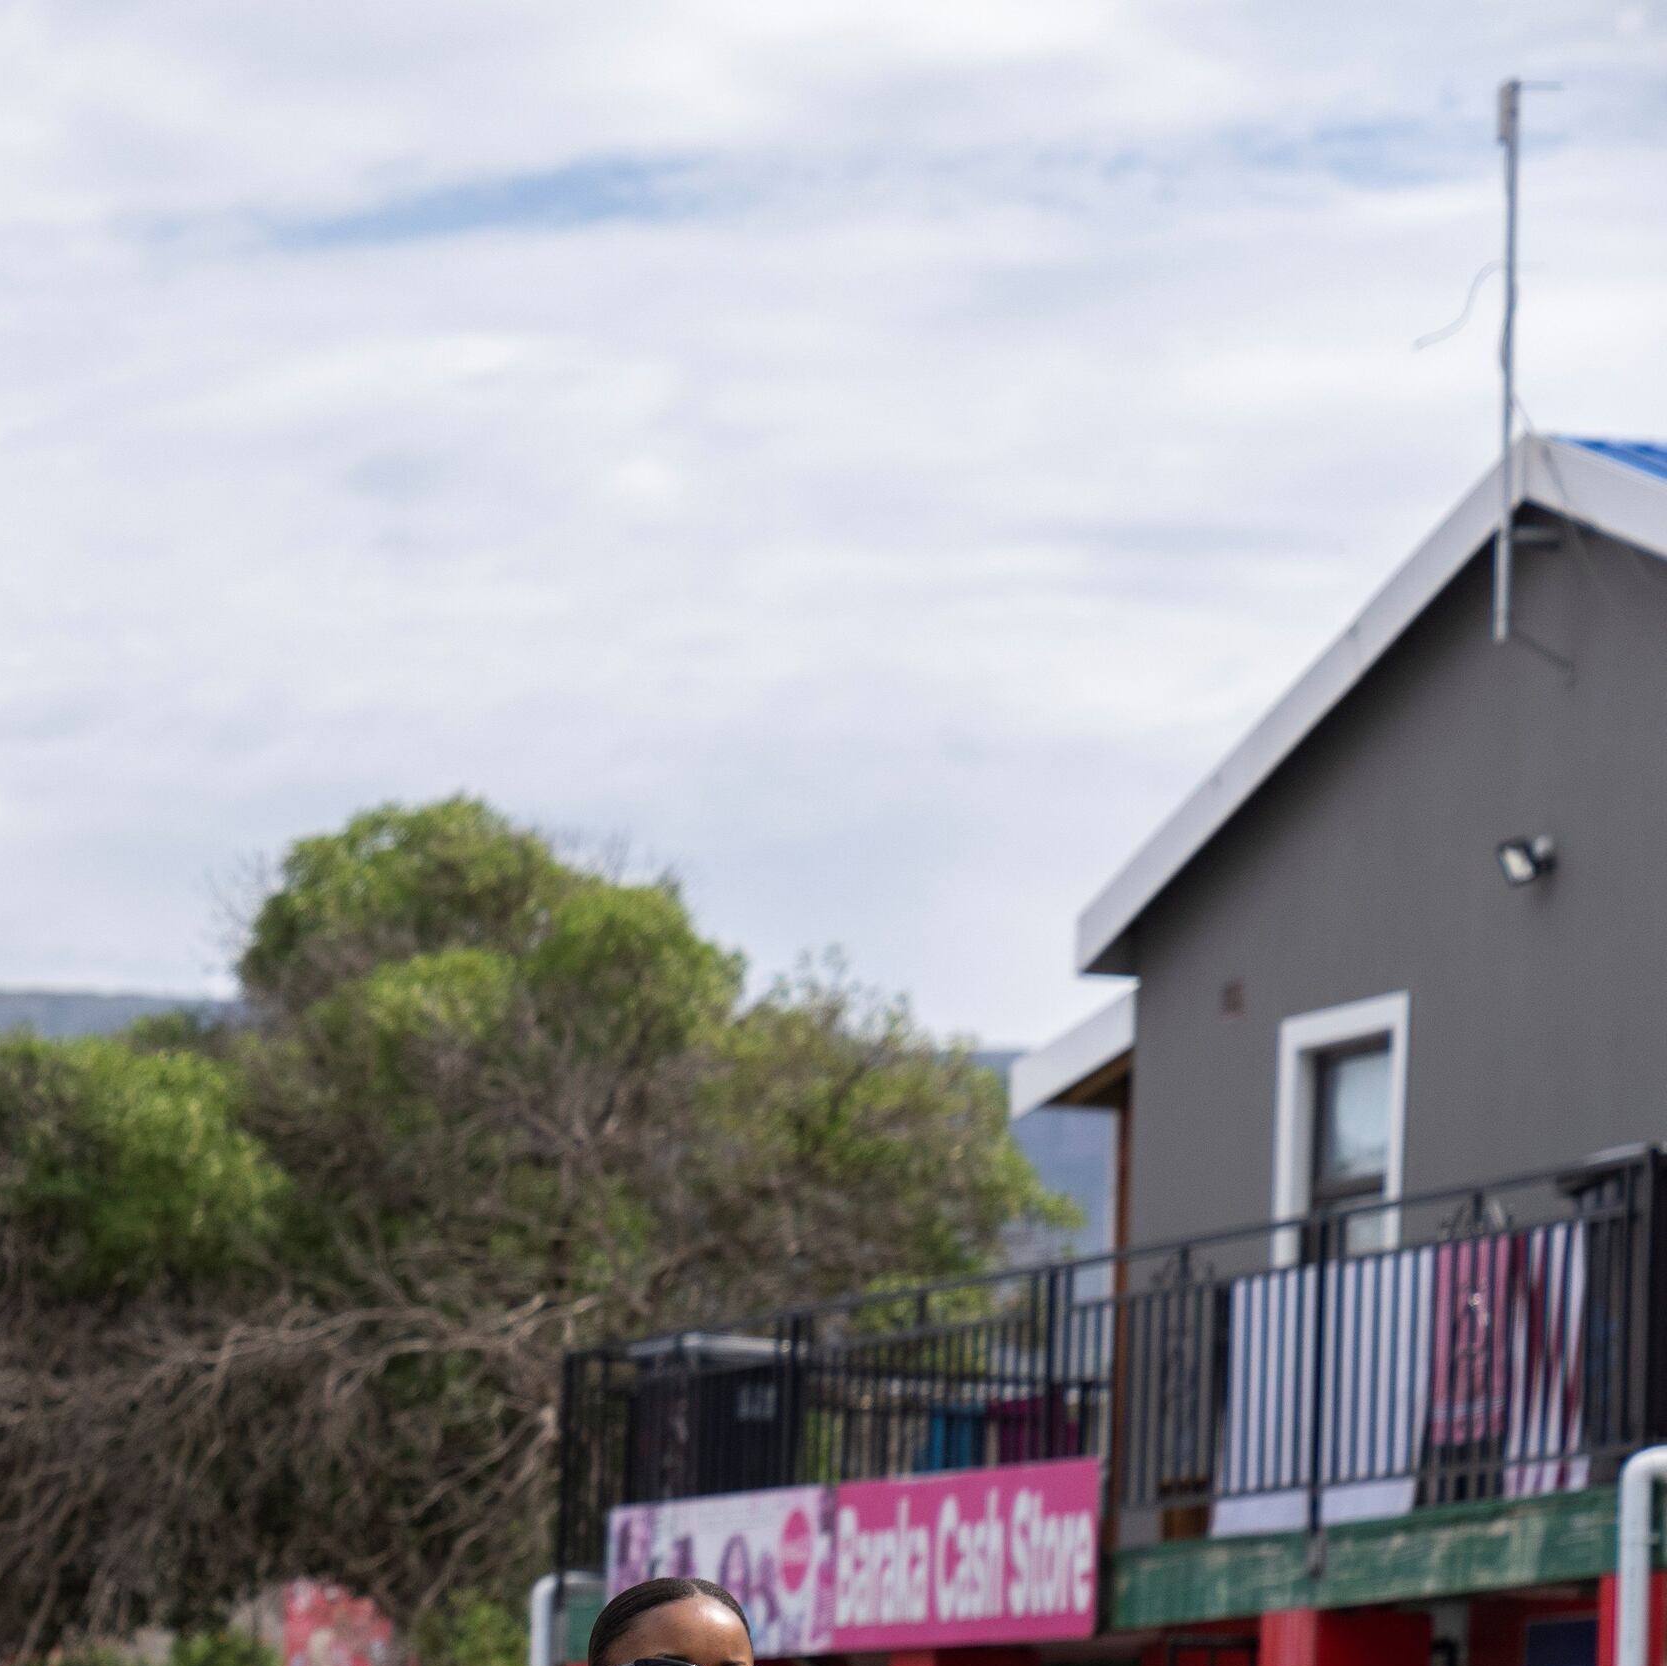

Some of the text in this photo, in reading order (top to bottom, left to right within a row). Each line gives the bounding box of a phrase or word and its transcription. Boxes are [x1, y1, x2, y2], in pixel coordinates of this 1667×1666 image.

[833, 1487, 1094, 1627] Baraka Cash Store
